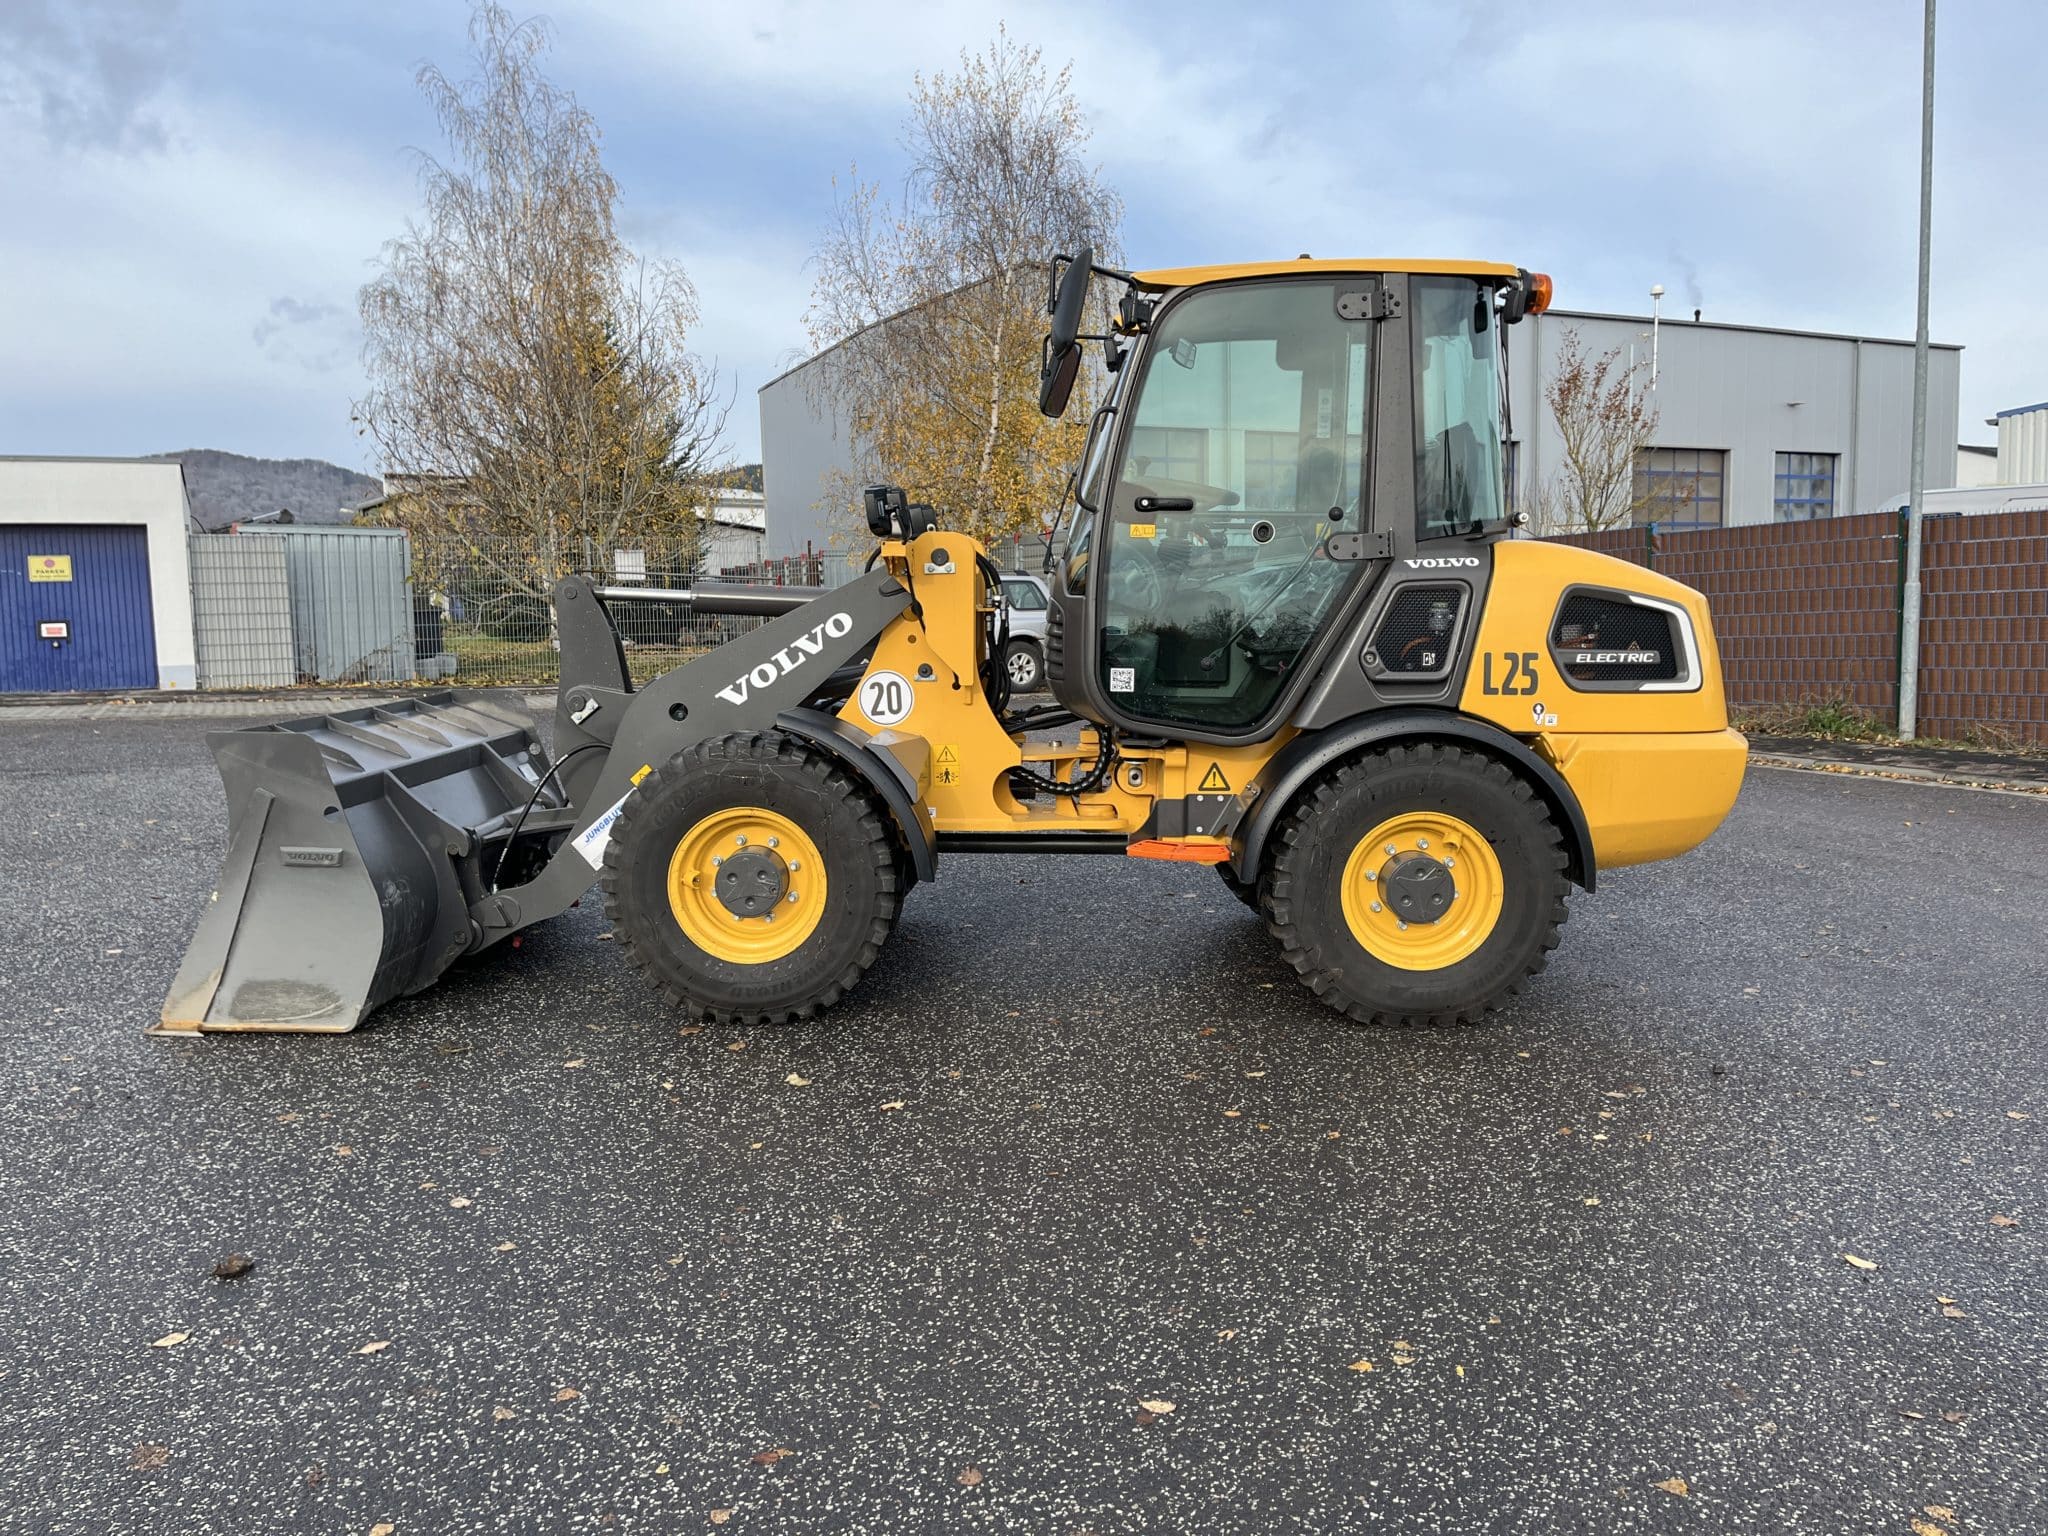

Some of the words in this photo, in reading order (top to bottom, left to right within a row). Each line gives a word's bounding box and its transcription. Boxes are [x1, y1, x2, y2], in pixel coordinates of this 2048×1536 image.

[1403, 557, 1480, 569] VOLVO
[714, 612, 853, 706] VOLVO
[1483, 652, 1539, 695] L25
[1575, 652, 1655, 663] ELECTRIC
[869, 680, 903, 716] 20
